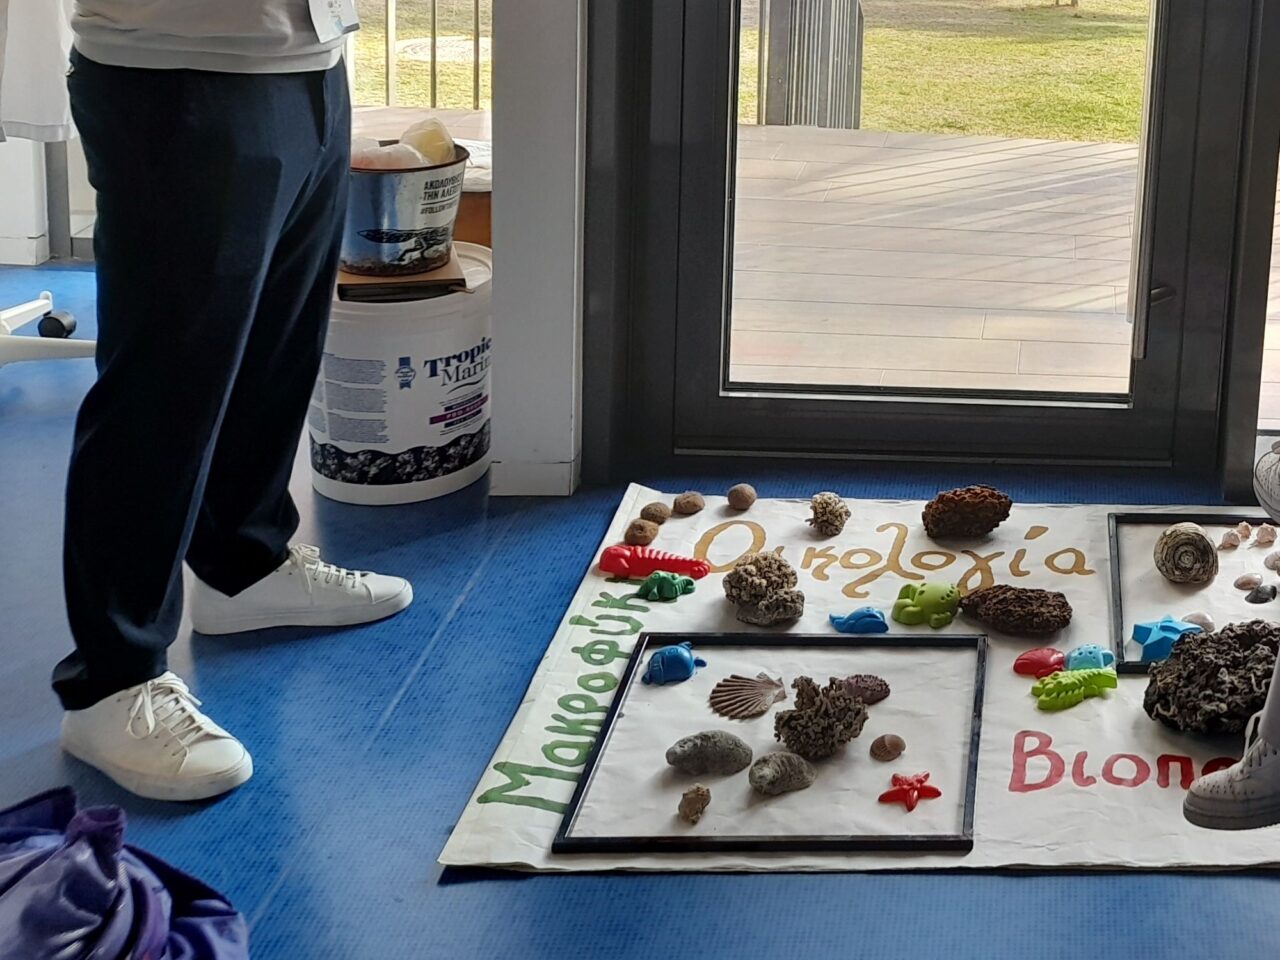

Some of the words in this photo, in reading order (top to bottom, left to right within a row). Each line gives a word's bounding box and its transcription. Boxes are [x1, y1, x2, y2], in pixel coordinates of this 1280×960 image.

[423, 189, 440, 201] ΤΗΝ
[693, 519, 1097, 599] Οκολογία
[476, 577, 650, 814] Μακροφύκ
